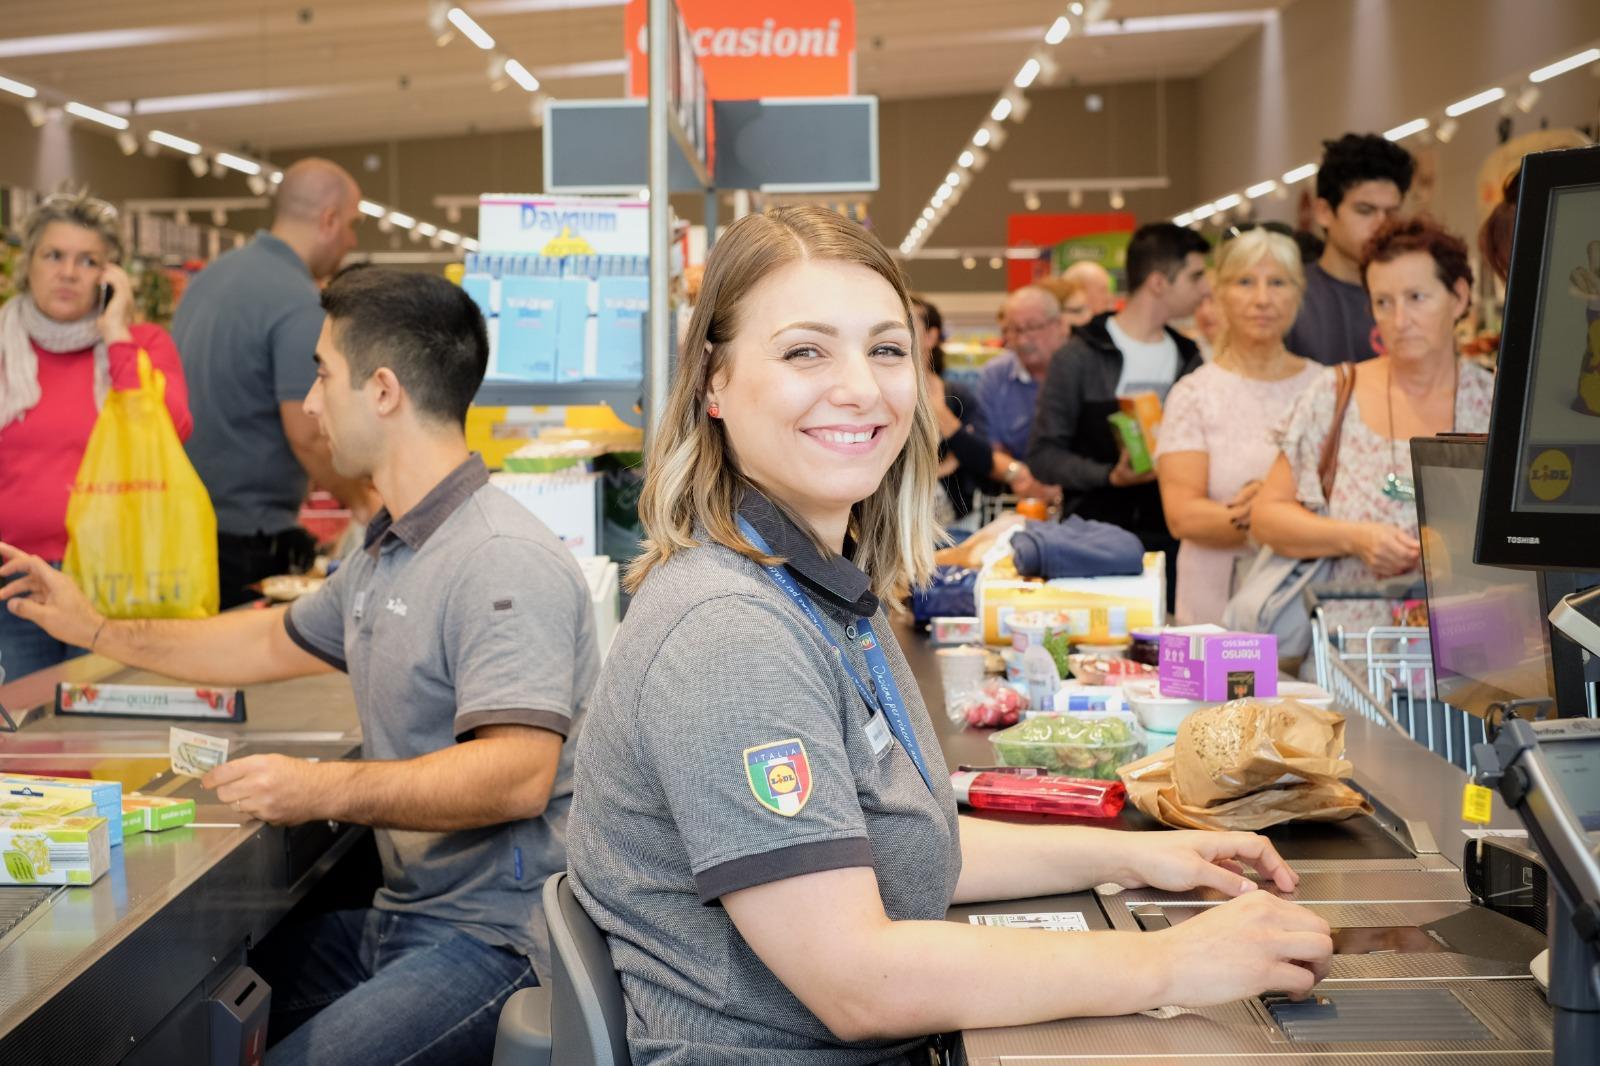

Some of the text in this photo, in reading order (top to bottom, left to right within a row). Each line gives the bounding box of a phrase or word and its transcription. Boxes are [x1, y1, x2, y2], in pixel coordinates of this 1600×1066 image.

[637, 18, 841, 57] casioni
[1506, 536, 1540, 544] TOSHIBA
[1221, 648, 1261, 660] Intenso
[884, 702, 899, 717] per
[754, 748, 797, 763] ITALIA
